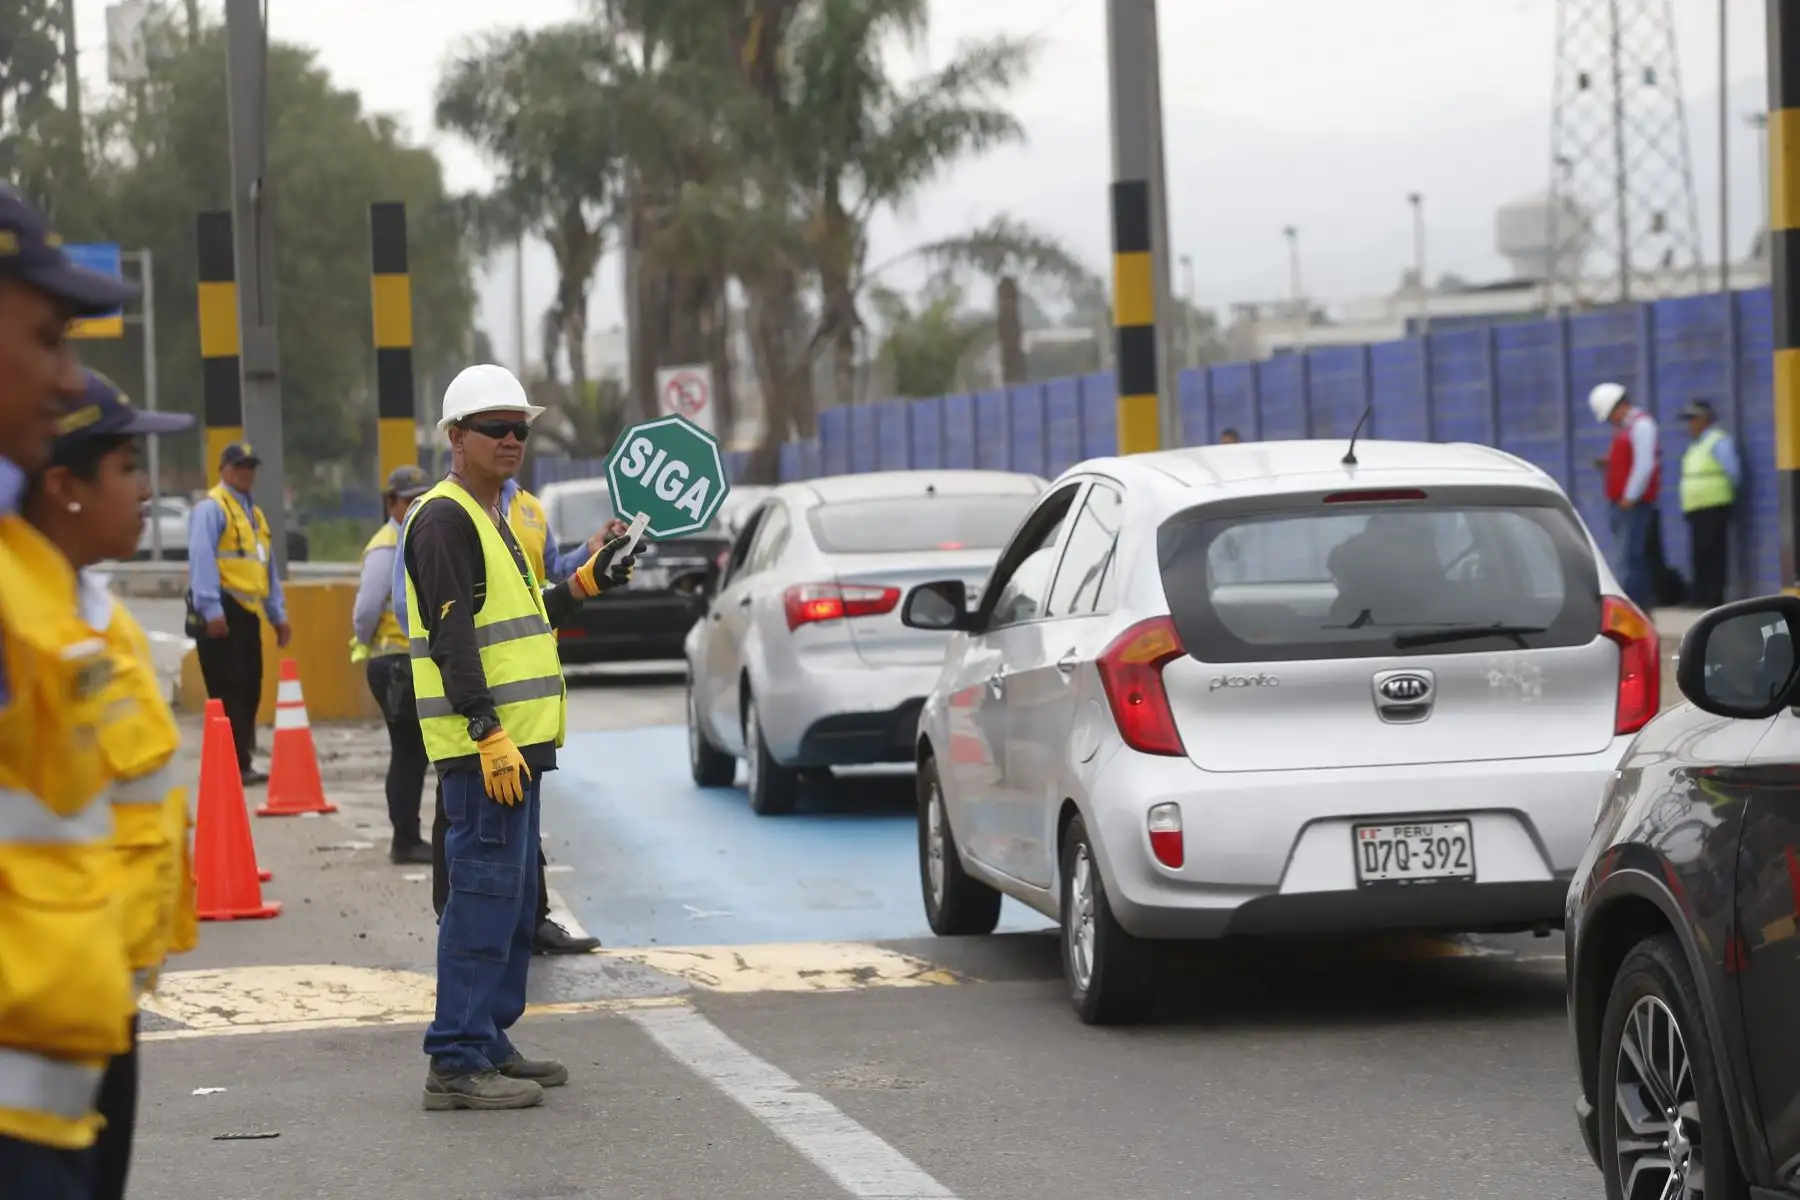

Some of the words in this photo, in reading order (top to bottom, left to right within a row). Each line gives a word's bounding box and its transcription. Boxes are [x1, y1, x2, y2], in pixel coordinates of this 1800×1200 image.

[620, 437, 710, 521] SIGA
[1388, 680, 1422, 697] KIA
[1393, 826, 1433, 838] PERU
[1363, 837, 1468, 873] D7Q-392
